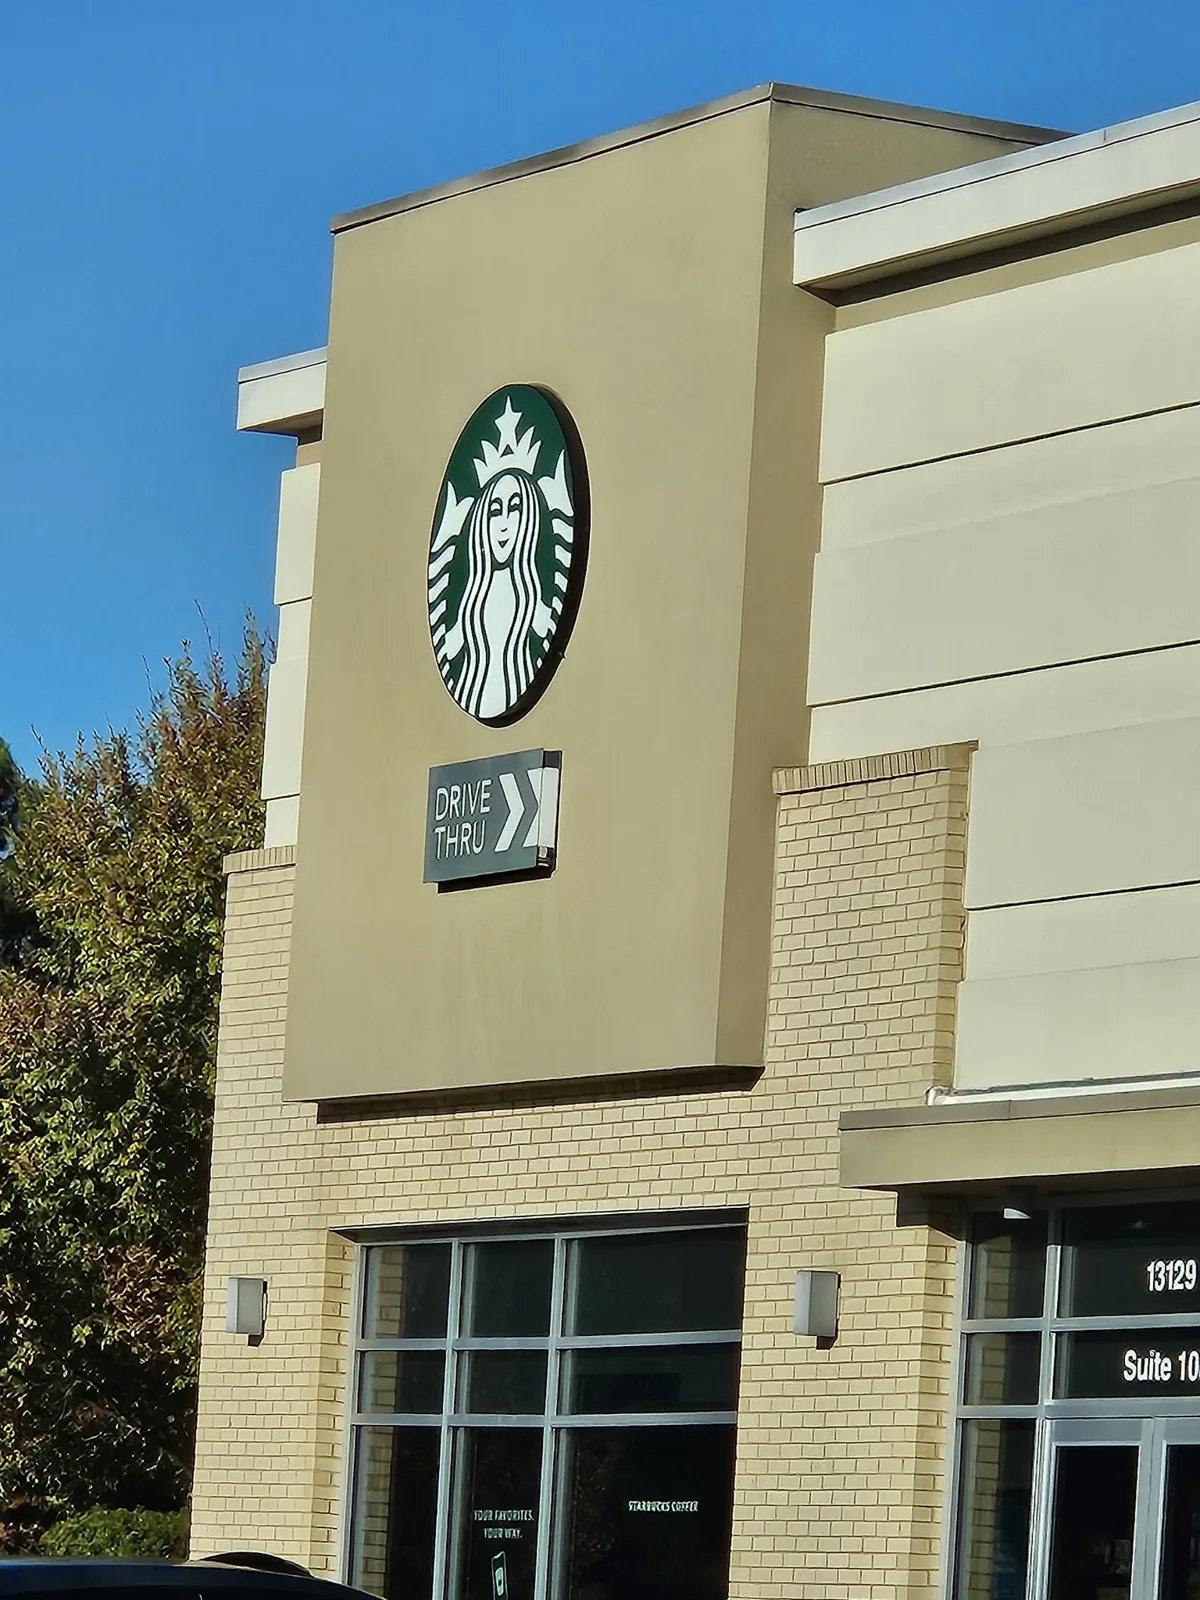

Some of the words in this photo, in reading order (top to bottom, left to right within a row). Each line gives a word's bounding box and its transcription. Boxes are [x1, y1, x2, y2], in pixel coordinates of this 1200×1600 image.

[435, 779, 492, 821] DRIVE
[434, 819, 486, 859] THRU
[1147, 1259, 1197, 1292] 13129
[1123, 1349, 1172, 1381] Suite
[1178, 1350, 1200, 1381] 10
[474, 1509, 493, 1521] YOUR
[628, 1500, 670, 1512] STARBUCKS
[483, 1527, 503, 1539] YOUR
